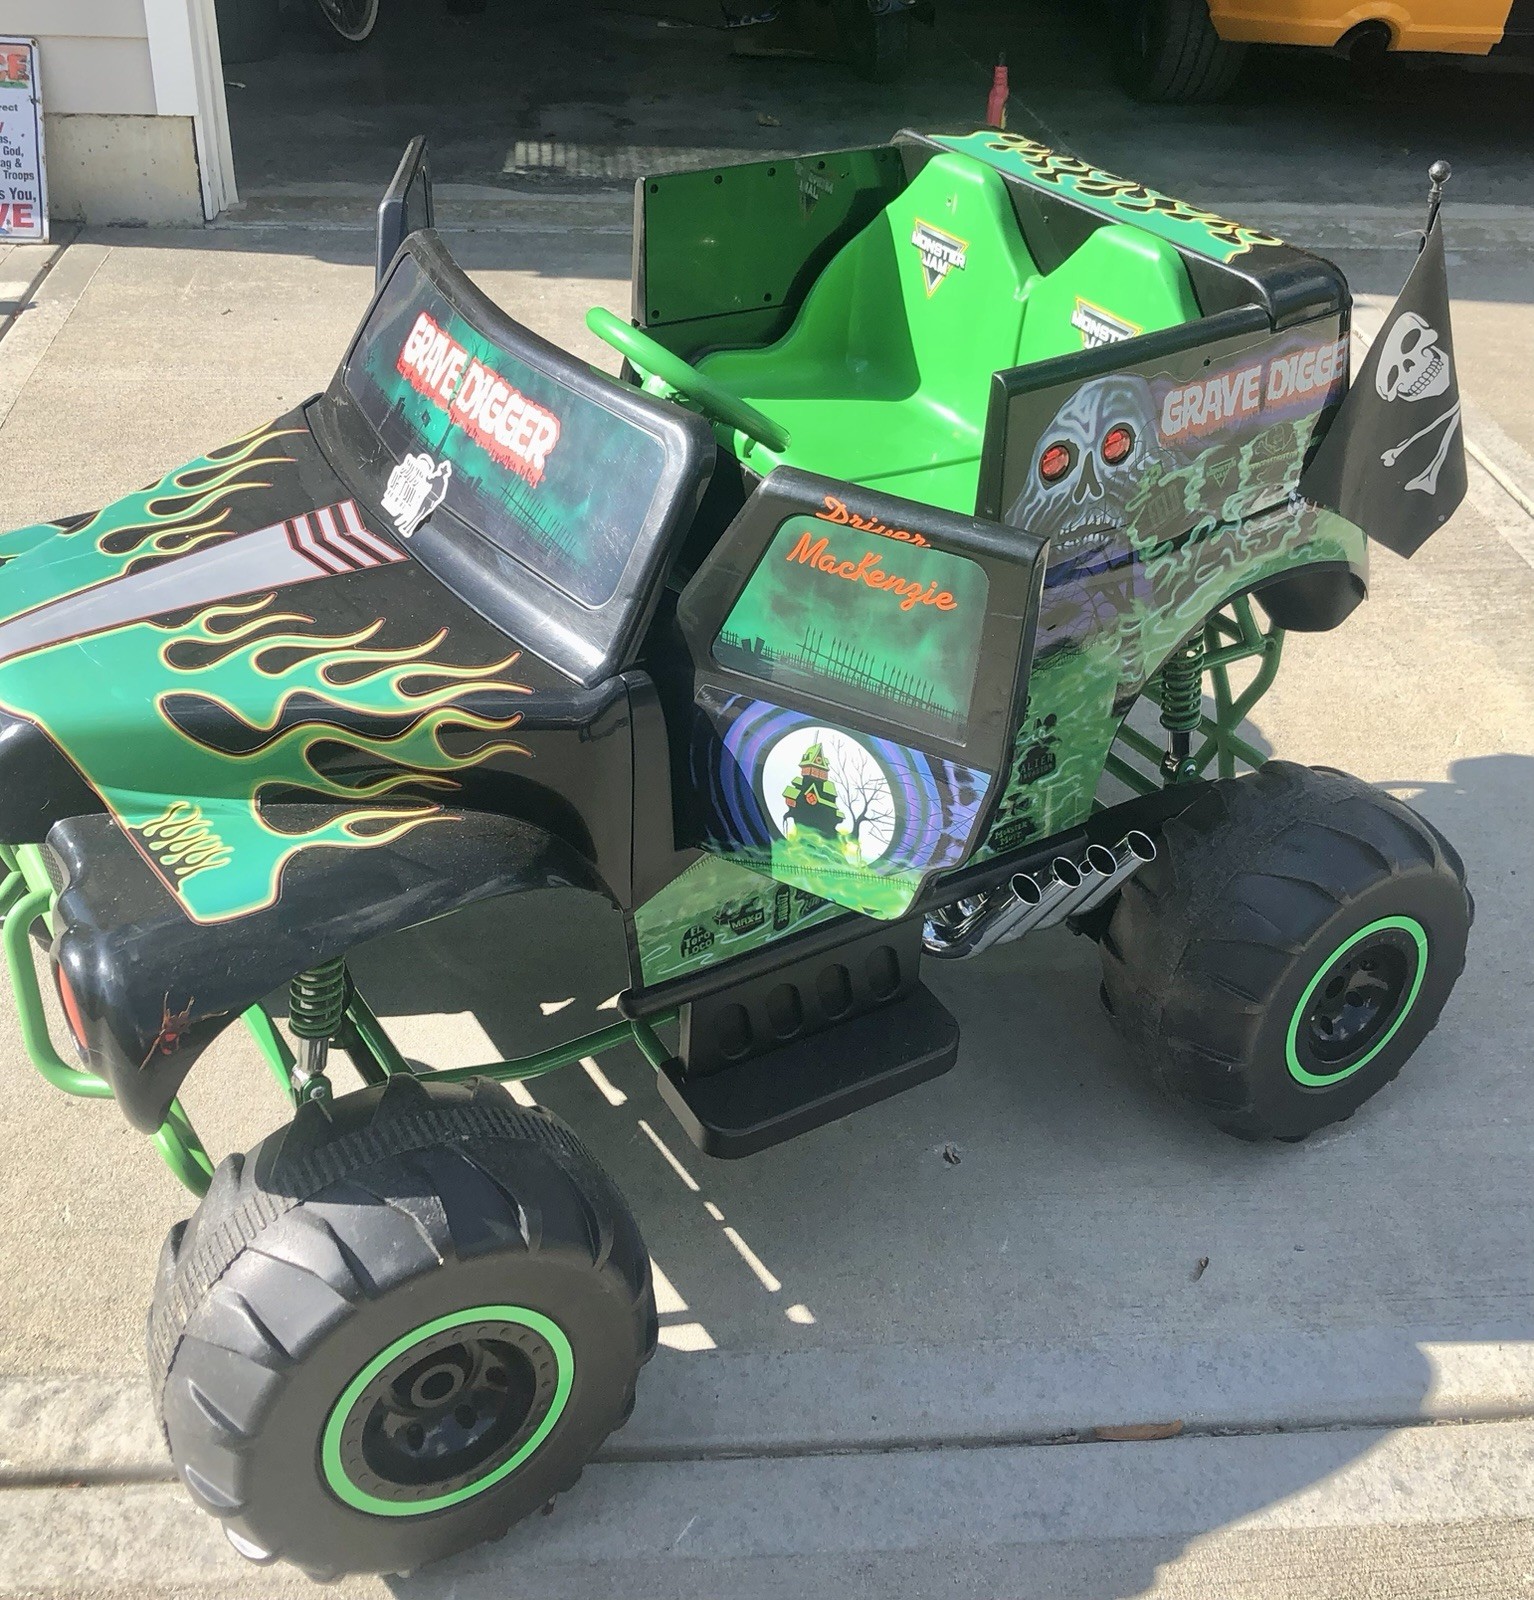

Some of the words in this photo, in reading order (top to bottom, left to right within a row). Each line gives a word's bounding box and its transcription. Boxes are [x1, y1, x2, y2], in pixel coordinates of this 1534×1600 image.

[3, 146, 24, 157] God,
[15, 158, 22, 168] &
[3, 170, 34, 182] Troops
[9, 187, 36, 202] You,
[911, 230, 967, 271] MONSTER
[922, 252, 948, 276] JAM
[1071, 310, 1131, 344] MONST
[1084, 335, 1104, 349] JA
[400, 312, 469, 402] GRAVE
[455, 360, 559, 470] DIGGER
[1161, 365, 1262, 437] GRAVE
[1267, 338, 1349, 401] DIGGE
[816, 496, 931, 547] Driver
[786, 532, 958, 611] MacKenzie
[690, 925, 703, 937] EL
